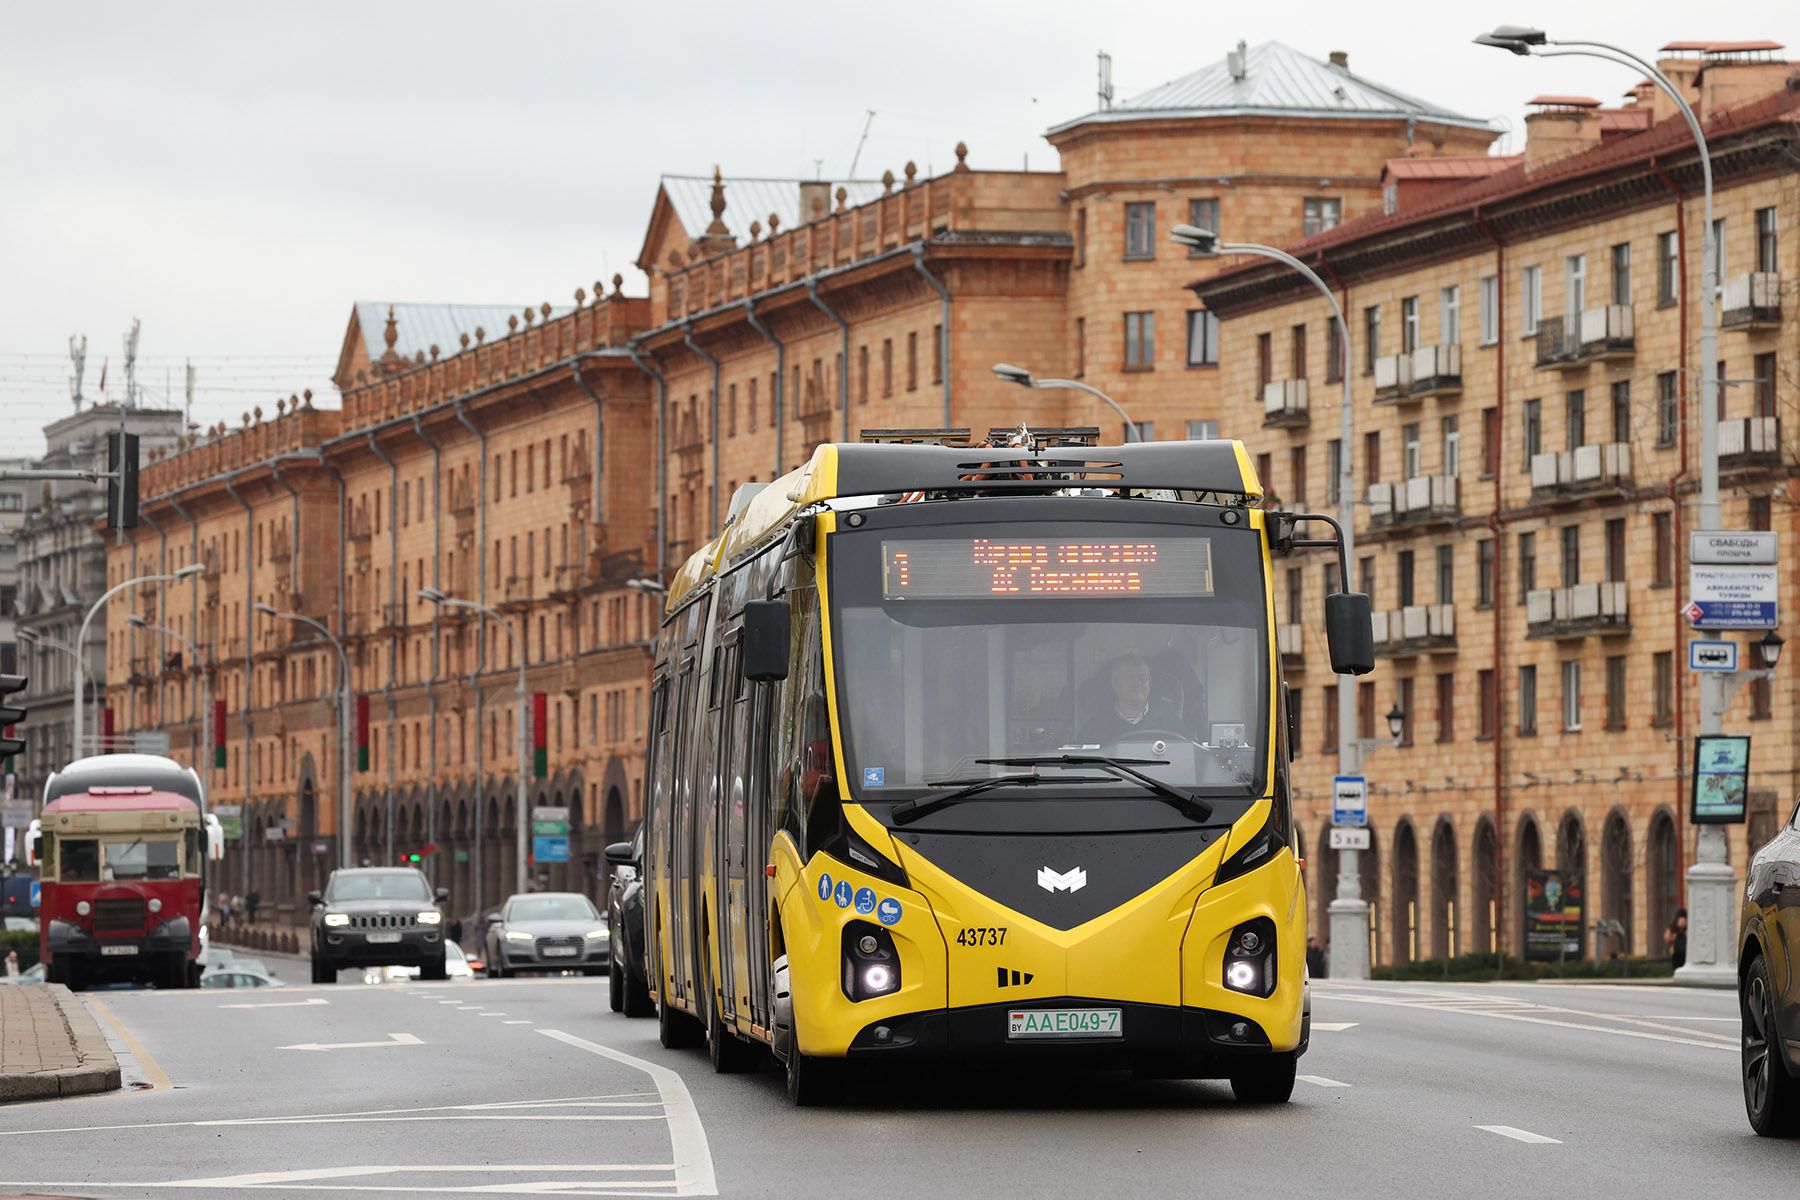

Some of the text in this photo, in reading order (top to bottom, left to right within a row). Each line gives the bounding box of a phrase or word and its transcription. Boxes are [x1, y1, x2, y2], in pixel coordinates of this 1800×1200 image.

[1709, 539, 1759, 548] СВАБОДЫ
[1716, 550, 1752, 558] ПЛОШЧА
[894, 553, 908, 585] 1
[957, 928, 1007, 946] 43737
[1011, 1023, 1022, 1032] BY
